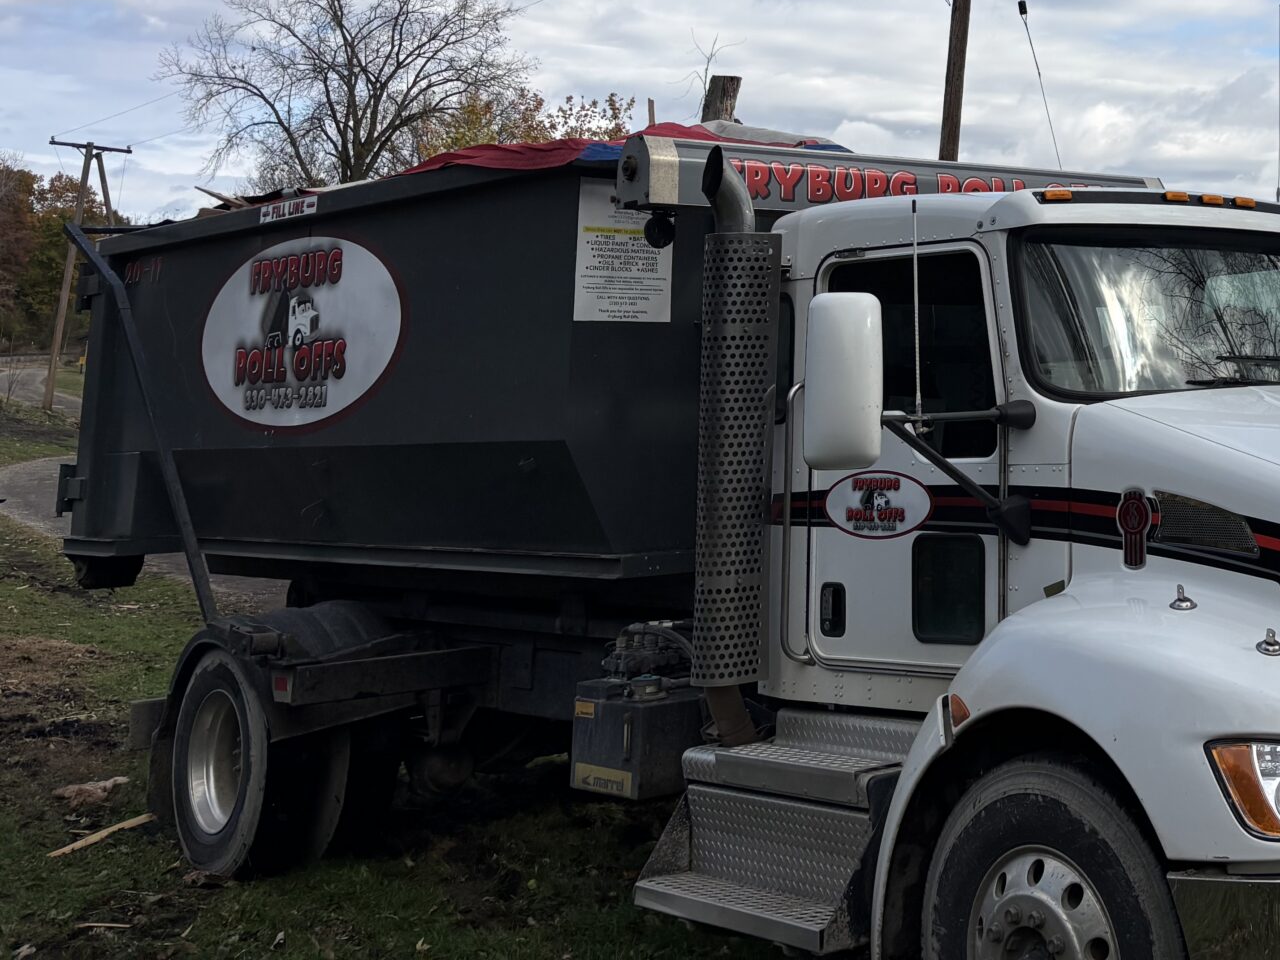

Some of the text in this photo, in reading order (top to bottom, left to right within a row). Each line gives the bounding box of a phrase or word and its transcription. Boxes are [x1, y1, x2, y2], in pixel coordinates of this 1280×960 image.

[271, 200, 305, 220] FILL LINE
[250, 247, 344, 296] FRYBURG
[234, 338, 347, 387] ROLL OFFS
[244, 384, 329, 411] 330-473-2821
[852, 478, 900, 491] FRYBURG
[846, 507, 905, 522] ROLL OFFS
